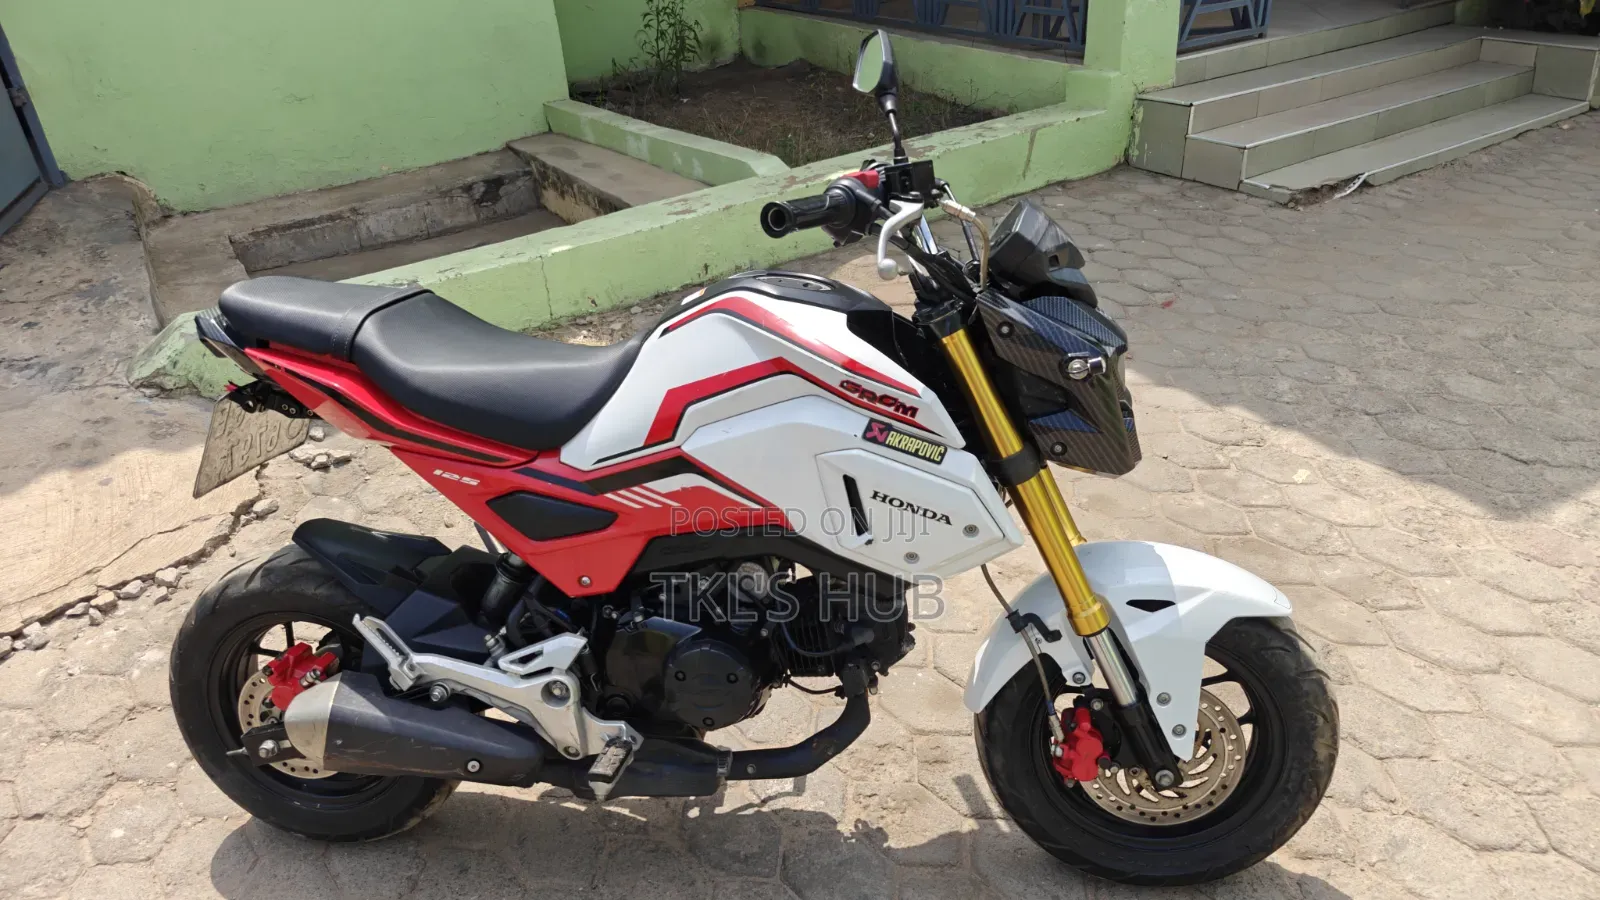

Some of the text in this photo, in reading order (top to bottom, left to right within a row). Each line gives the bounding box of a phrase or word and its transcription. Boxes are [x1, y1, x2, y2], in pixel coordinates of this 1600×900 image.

[839, 380, 919, 419] GROM
[433, 469, 480, 486] 125
[870, 490, 952, 525] HONDA
